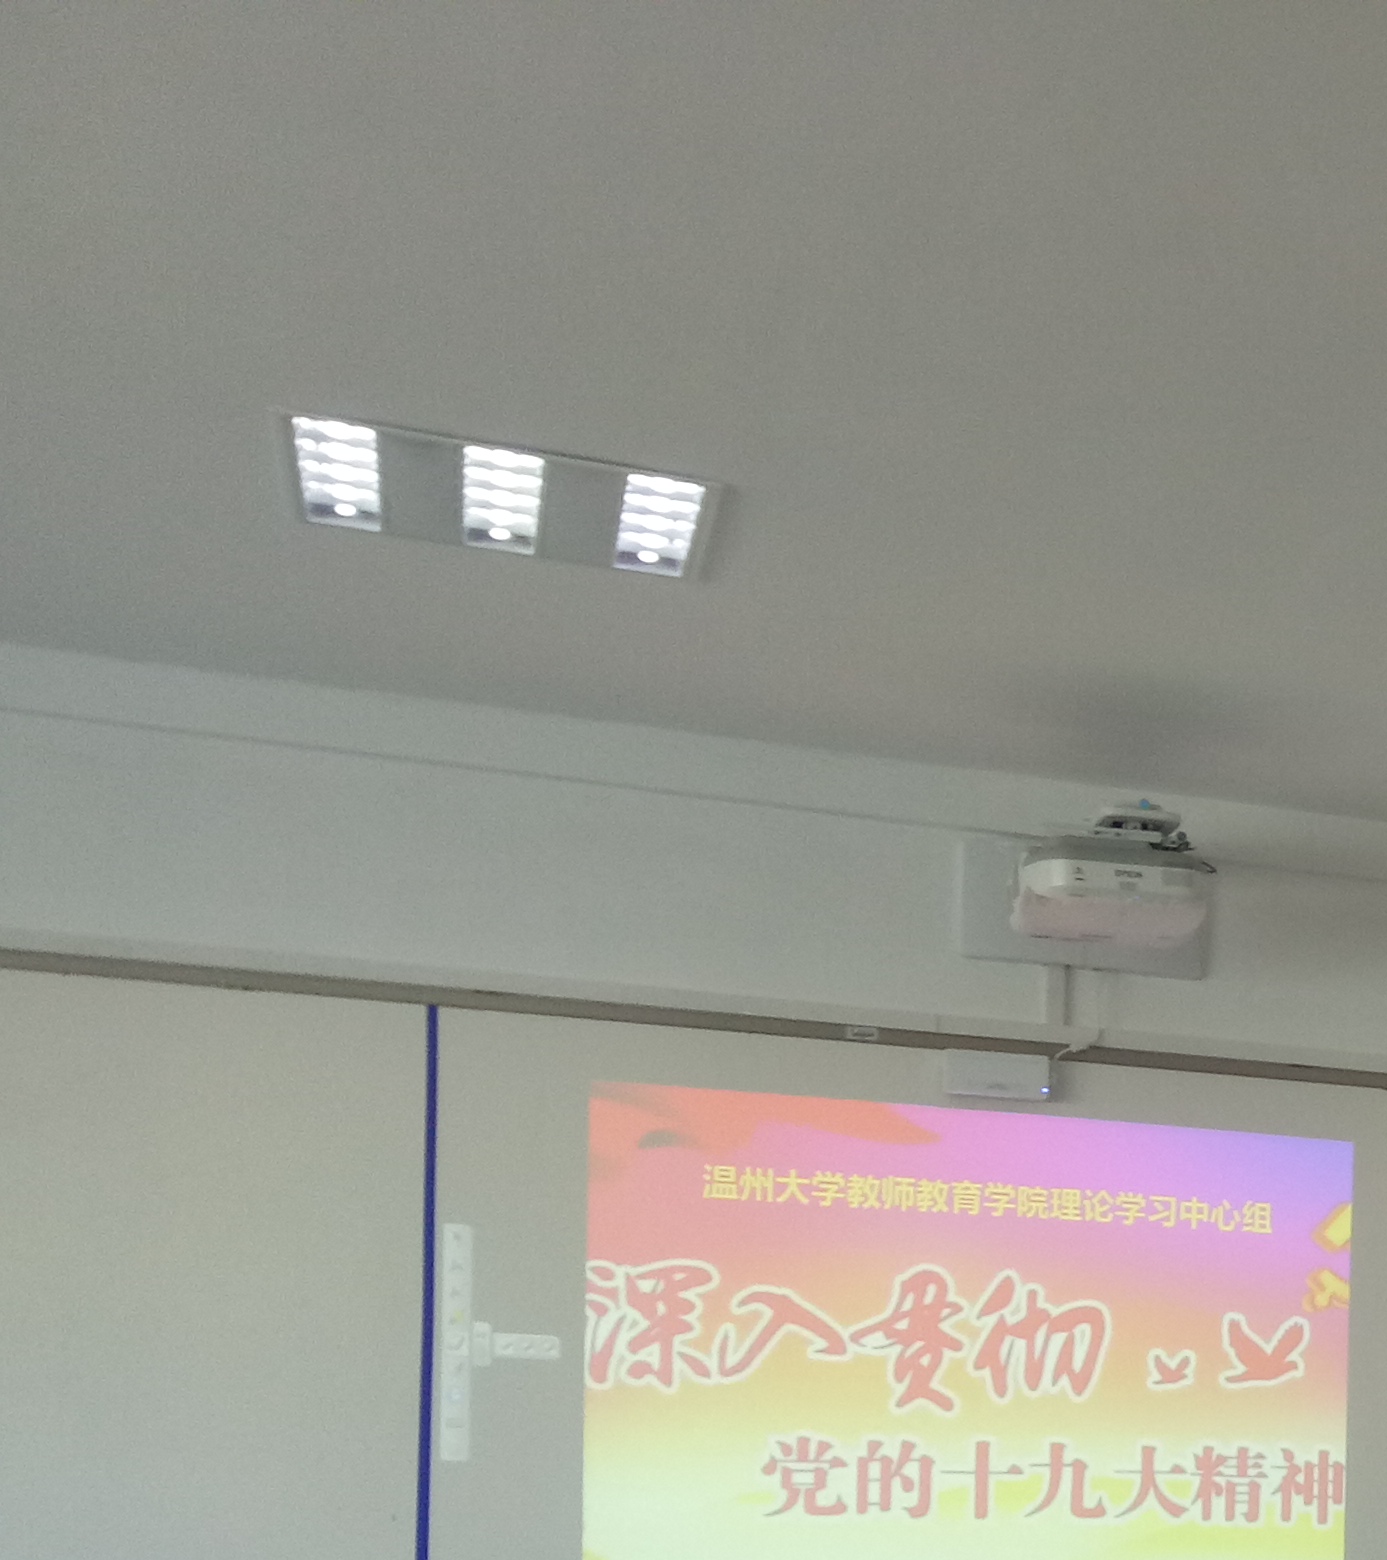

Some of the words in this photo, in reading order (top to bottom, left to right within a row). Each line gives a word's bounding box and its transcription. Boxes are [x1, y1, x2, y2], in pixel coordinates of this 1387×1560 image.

[702, 1164, 1273, 1235] 温州大学教师教育学院理论学习中心组
[761, 1436, 1345, 1525] 党的十九大精神
